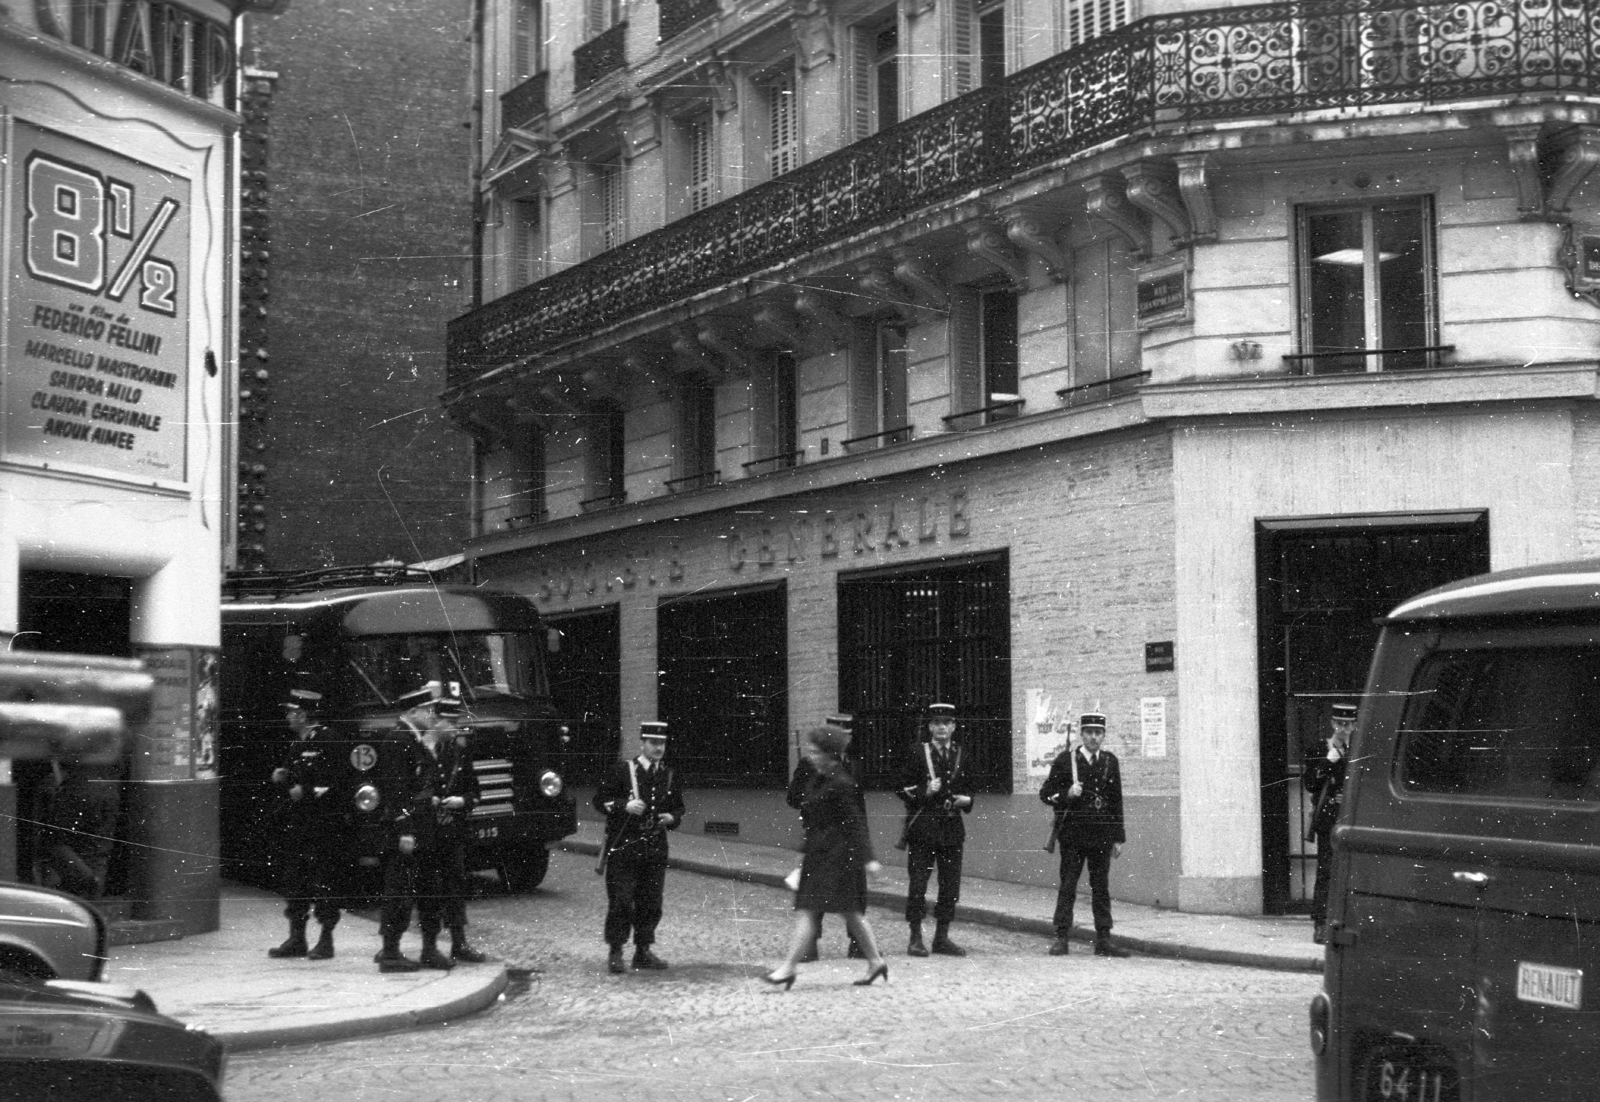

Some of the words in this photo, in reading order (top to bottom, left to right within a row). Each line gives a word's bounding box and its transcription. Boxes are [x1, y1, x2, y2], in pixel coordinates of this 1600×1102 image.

[33, 305, 105, 341] FEDERICO
[107, 323, 162, 356] FELLINI
[25, 339, 94, 369] MARCELLO
[49, 370, 104, 396] SANDRA
[106, 382, 142, 404] MILO
[31, 391, 88, 417] CLAUDIA
[91, 402, 161, 432] CARDINALE
[43, 418, 92, 442] ANOUK
[354, 747, 374, 767] 13
[1522, 968, 1579, 1004] RENAULT
